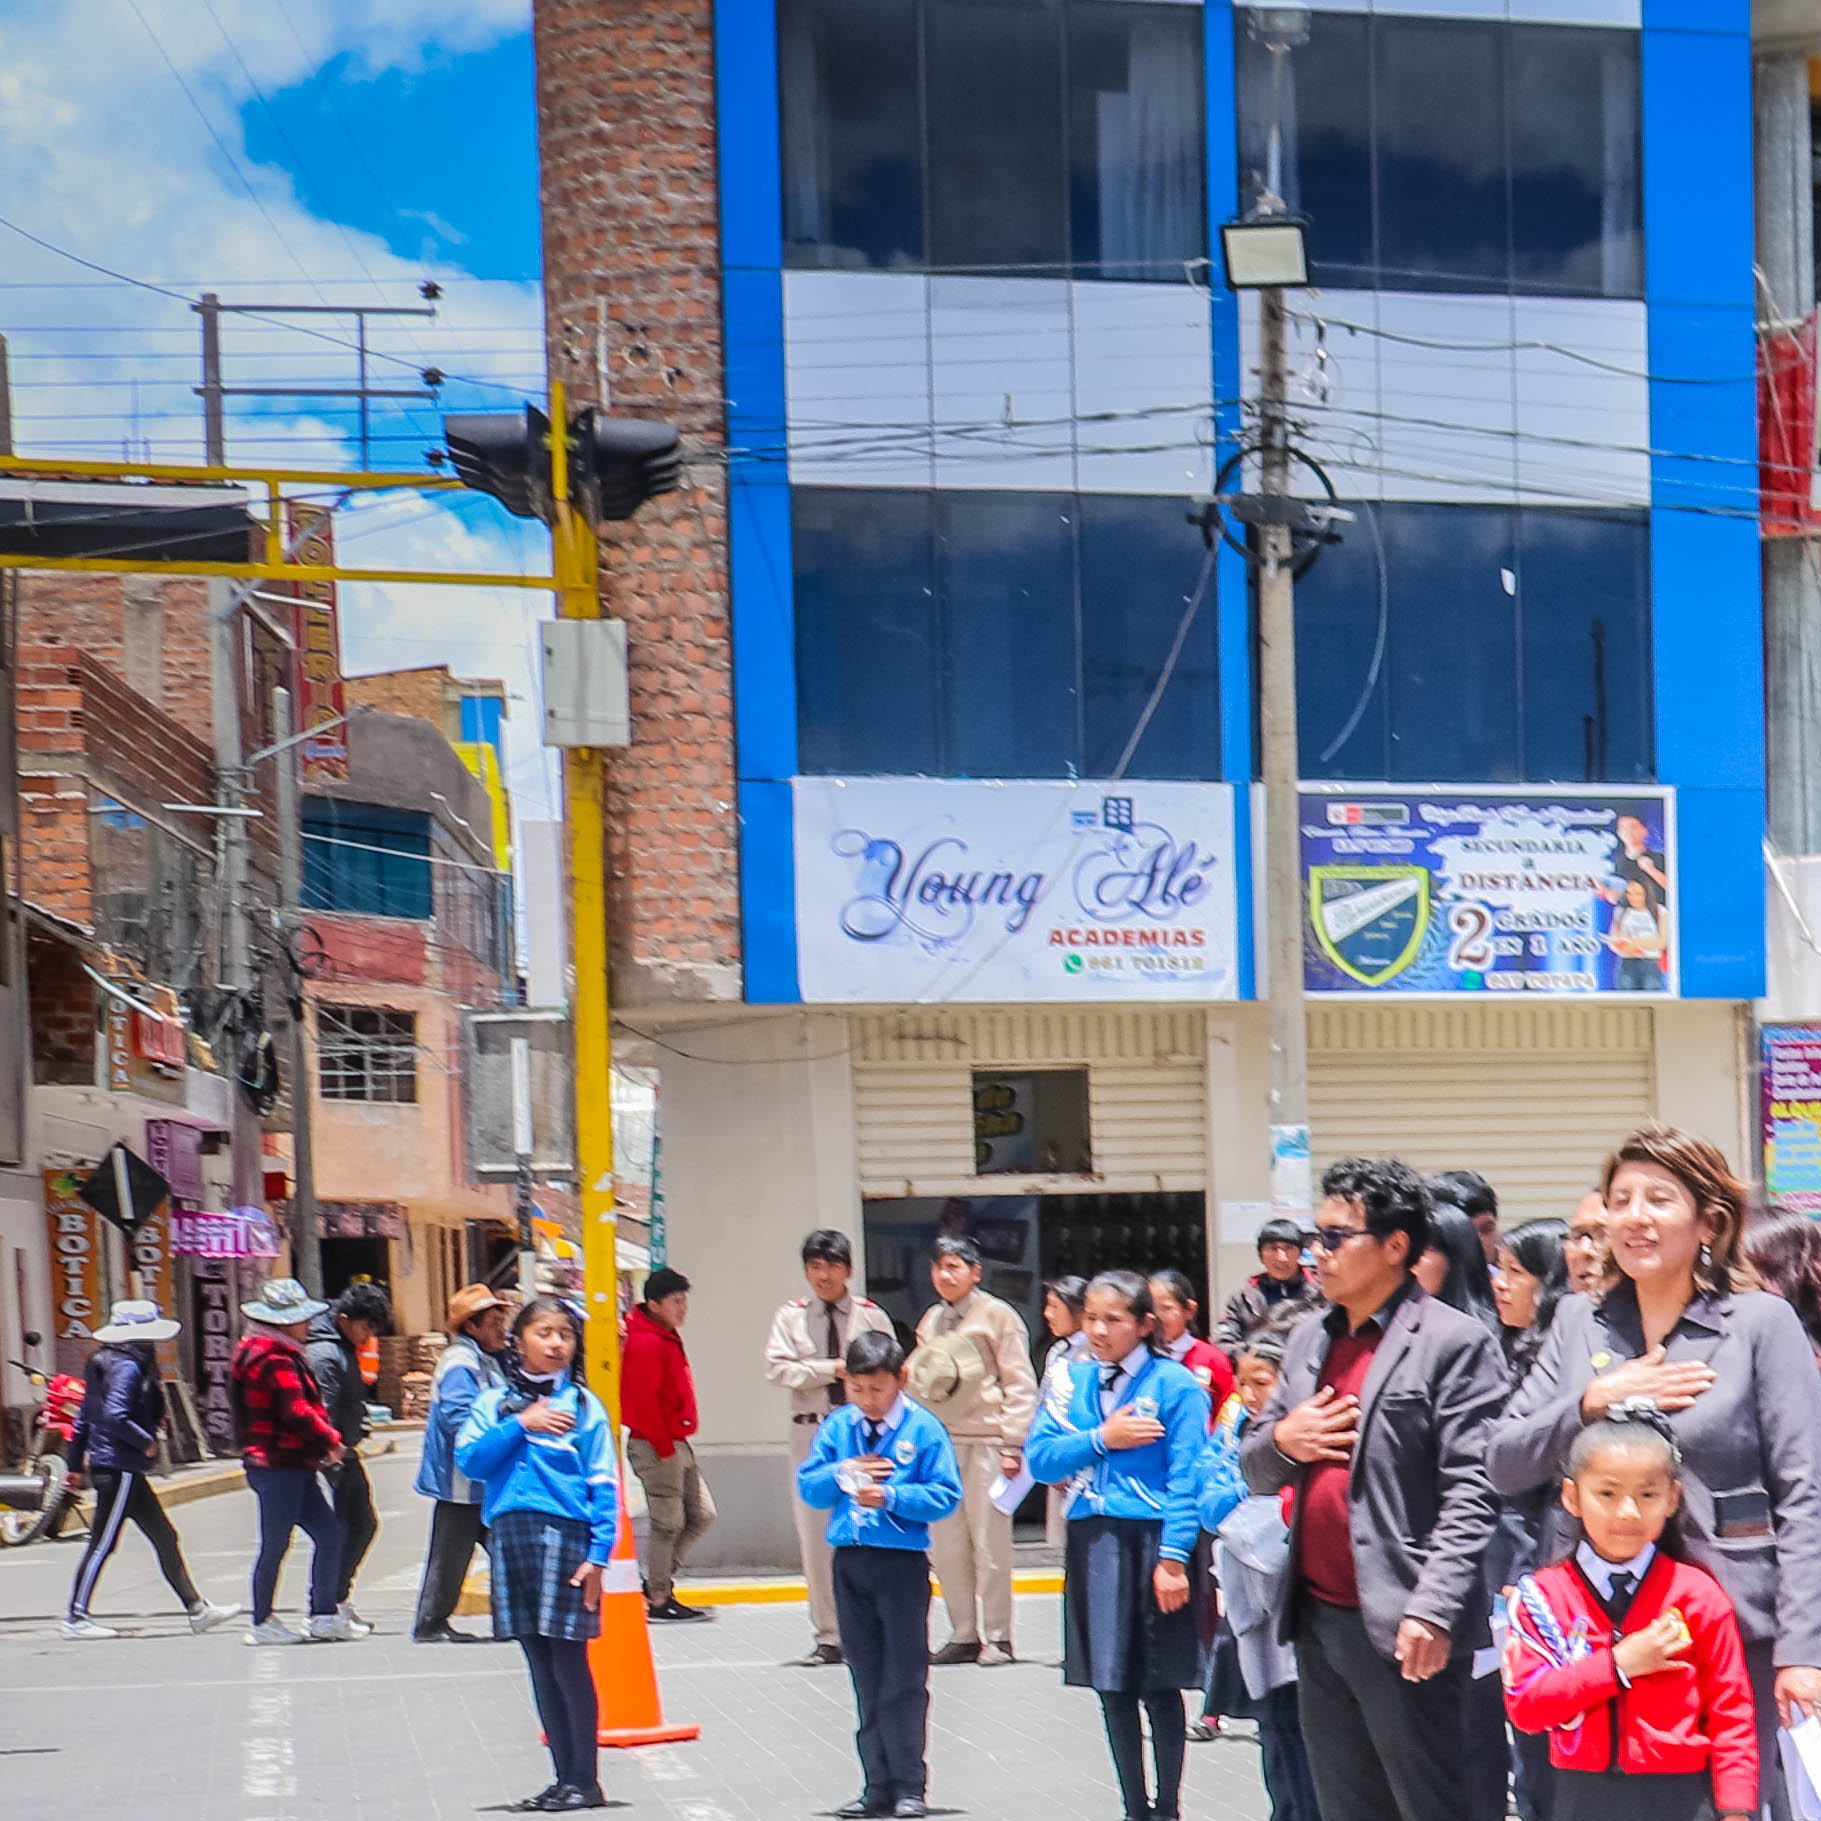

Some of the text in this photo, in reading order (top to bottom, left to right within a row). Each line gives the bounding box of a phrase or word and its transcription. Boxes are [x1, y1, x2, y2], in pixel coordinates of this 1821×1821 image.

[1460, 838, 1588, 855] SECUNDARIA
[1460, 872, 1601, 890] DISTANCIA
[1049, 929, 1206, 946] ACADEMIAS
[1454, 904, 1490, 966] 2
[55, 1212, 94, 1339] BOTICA
[202, 1281, 233, 1437] TORTAS
